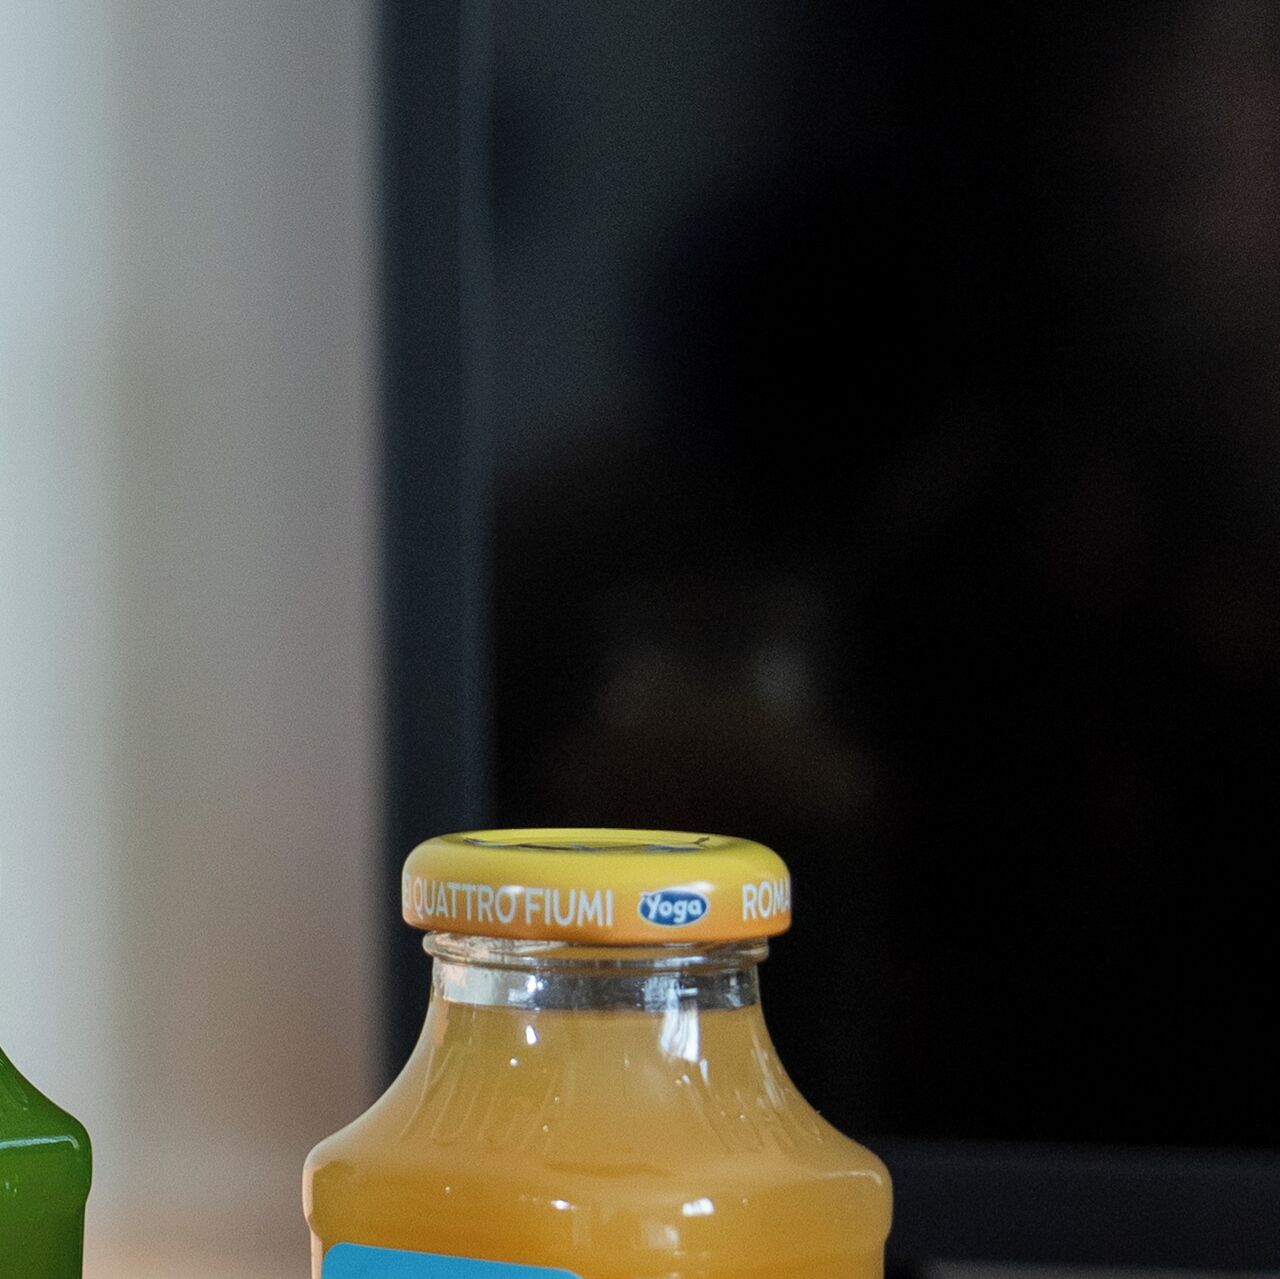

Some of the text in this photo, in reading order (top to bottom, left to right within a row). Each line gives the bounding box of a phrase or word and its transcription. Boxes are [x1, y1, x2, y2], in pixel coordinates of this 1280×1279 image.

[414, 877, 518, 925] QUATTRO
[523, 886, 614, 927] FIUMI
[643, 893, 703, 924] Yoga
